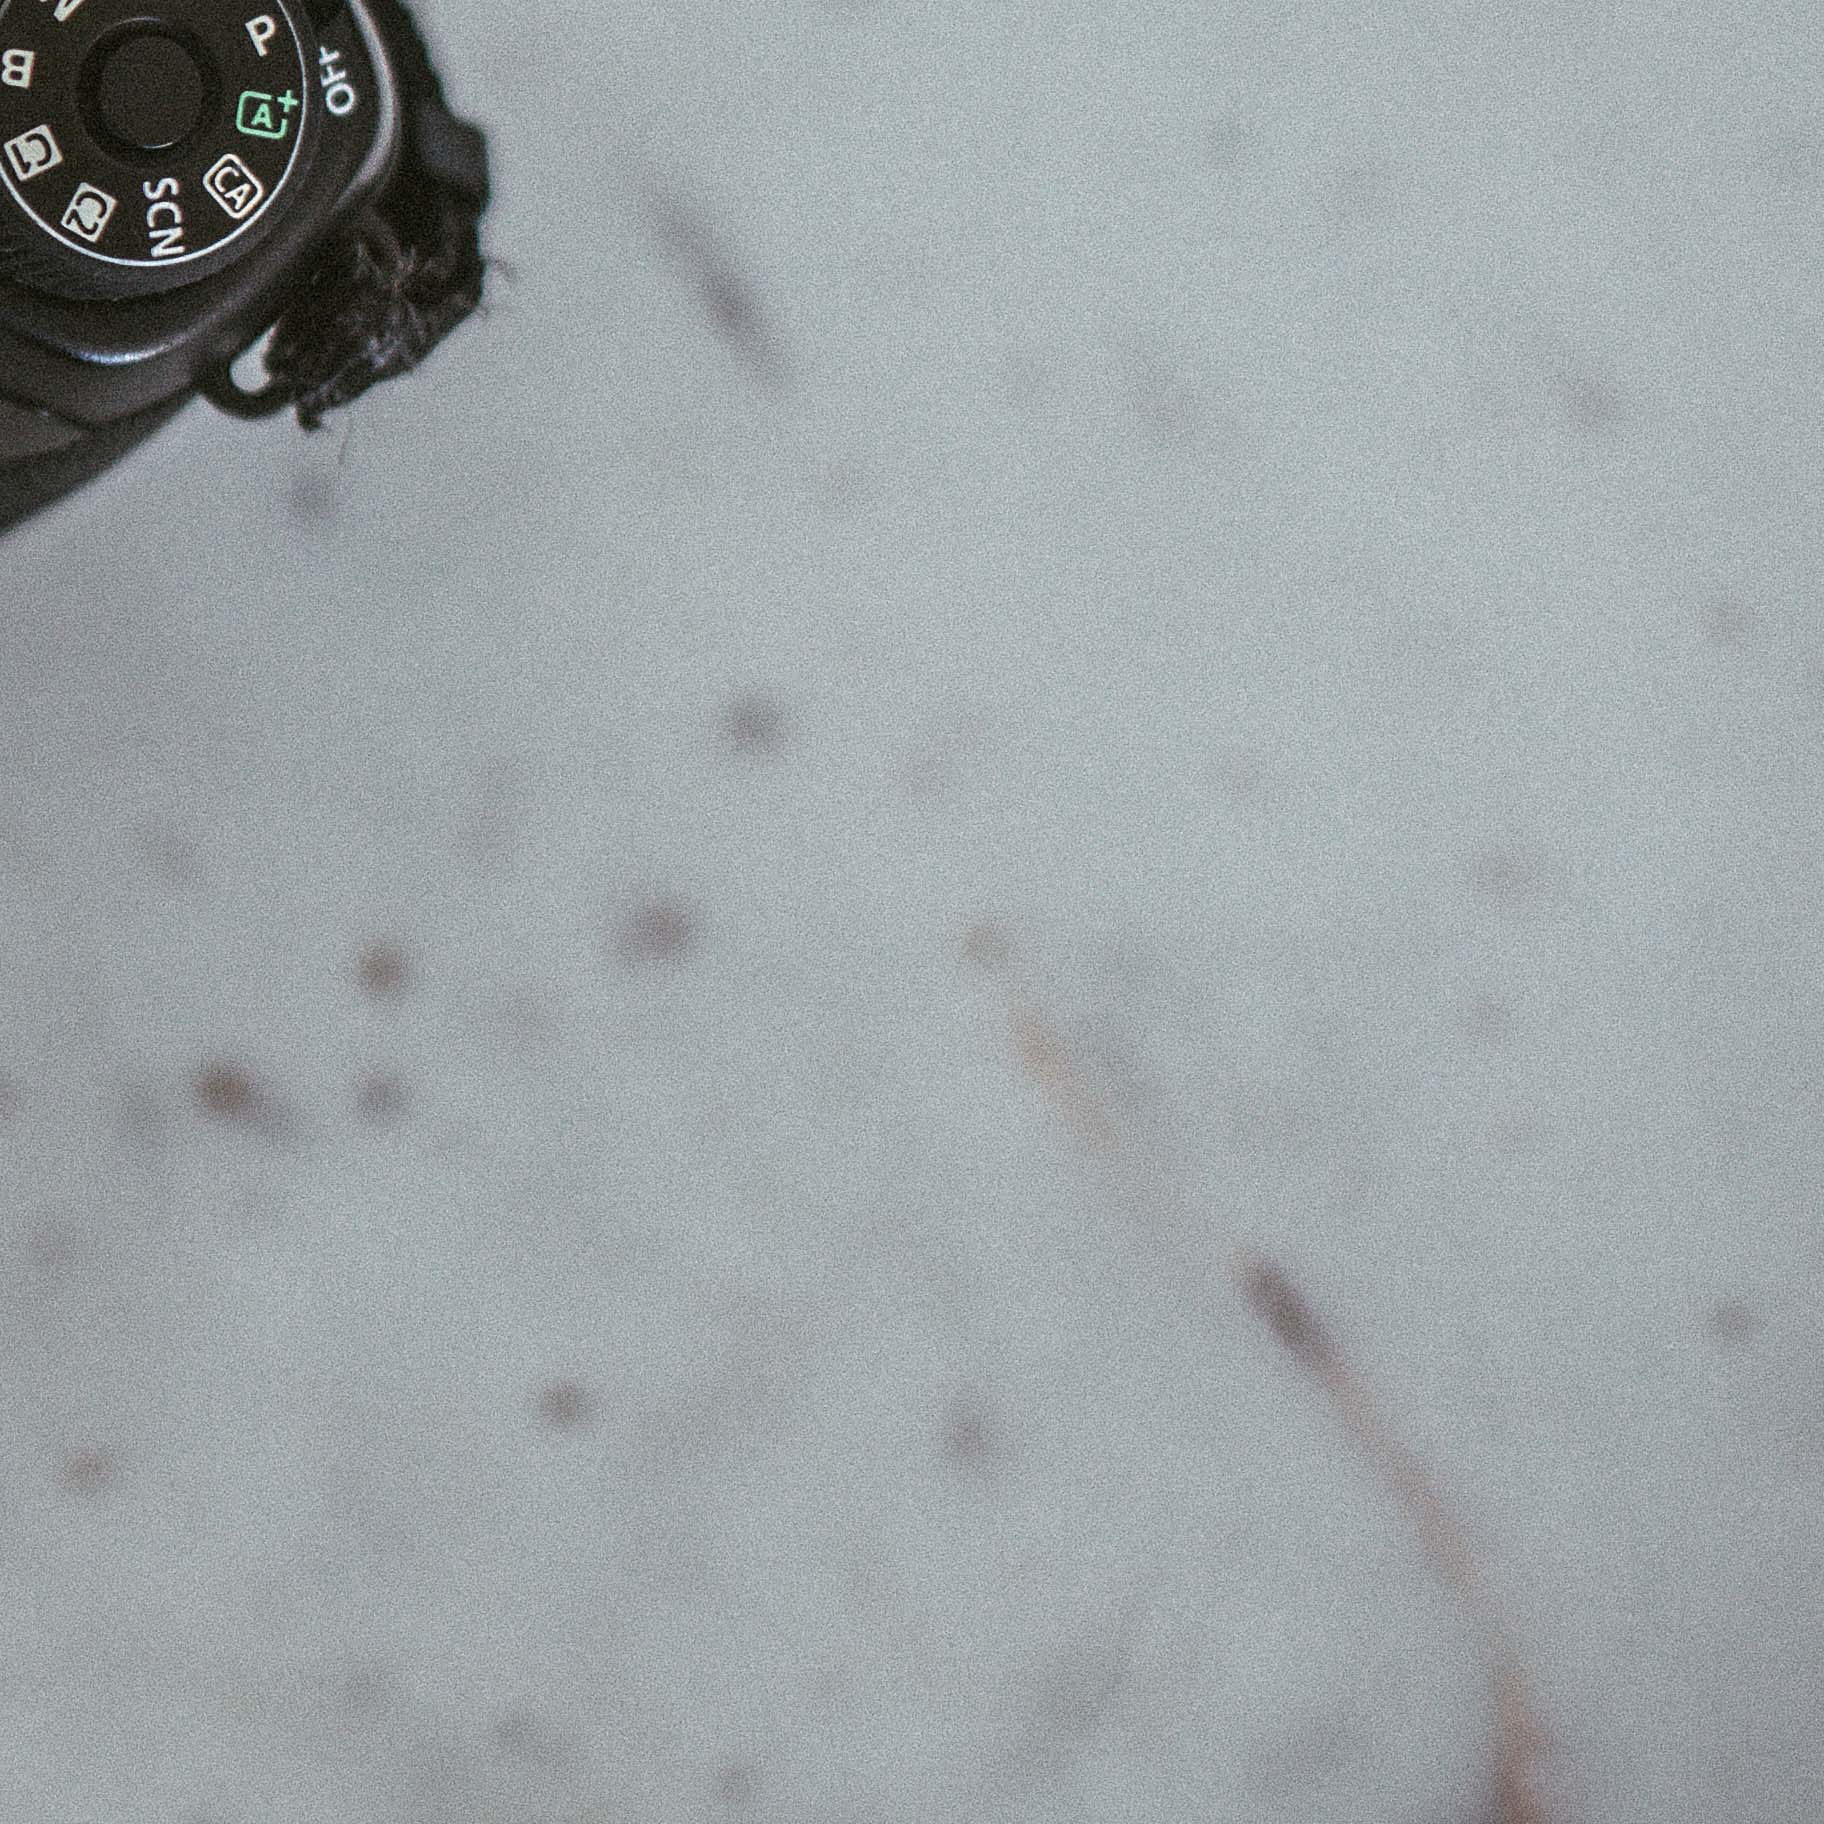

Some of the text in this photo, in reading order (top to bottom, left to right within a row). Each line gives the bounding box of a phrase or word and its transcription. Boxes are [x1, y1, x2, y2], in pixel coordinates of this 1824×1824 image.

[245, 14, 277, 57] P
[1, 48, 36, 89] B
[319, 46, 356, 116] OFF
[9, 127, 60, 176] C1
[66, 188, 112, 236] C2
[212, 165, 253, 212] CA
[143, 176, 186, 258] SCN
